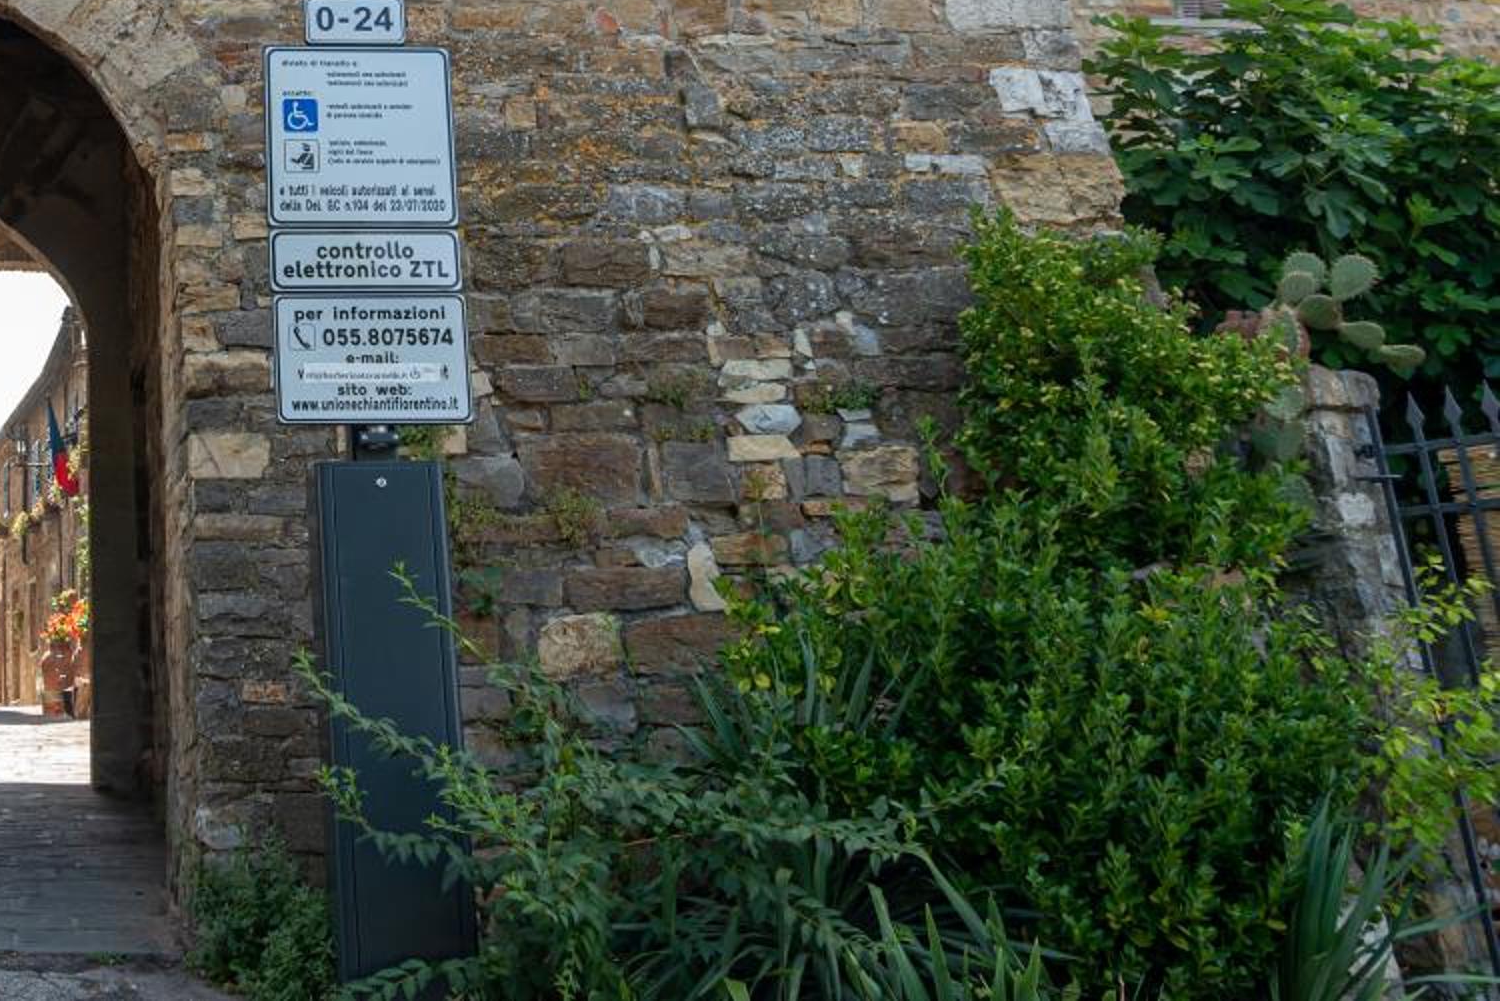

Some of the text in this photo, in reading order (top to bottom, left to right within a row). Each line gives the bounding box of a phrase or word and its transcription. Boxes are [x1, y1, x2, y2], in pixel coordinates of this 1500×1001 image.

[316, 6, 394, 32] 0-24
[317, 241, 414, 260] controllo
[283, 260, 449, 278] elettronico ZTL
[294, 306, 446, 323] per informazioni
[323, 328, 454, 346] 055.8075674
[345, 351, 399, 364] e-mail:
[337, 383, 412, 396] sito web:
[291, 396, 459, 412] www.unionechiantifiorentino.it
